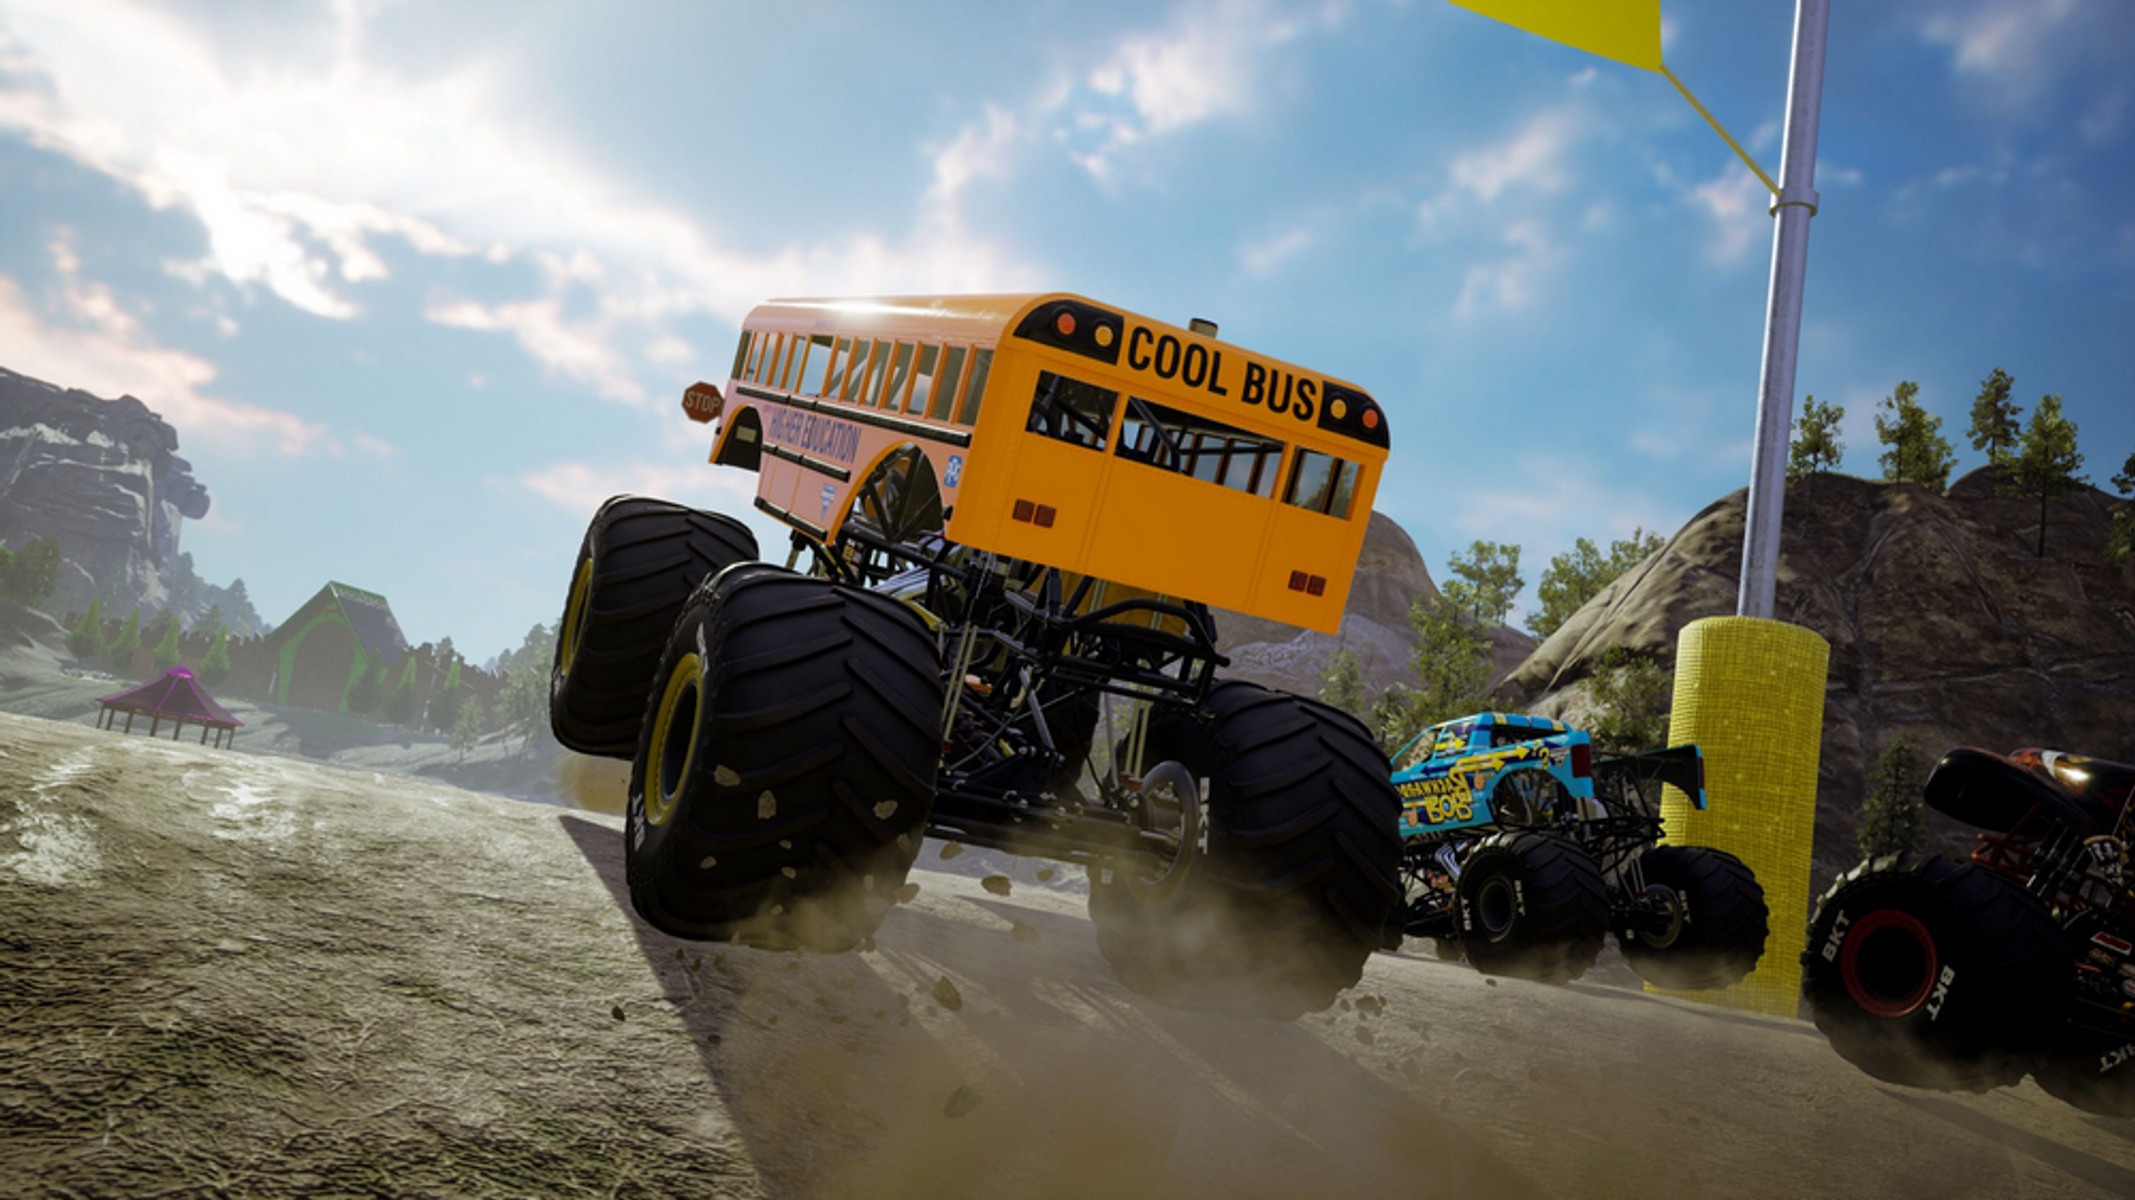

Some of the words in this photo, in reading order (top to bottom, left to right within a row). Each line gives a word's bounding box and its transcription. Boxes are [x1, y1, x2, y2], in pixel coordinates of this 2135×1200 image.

[1128, 325, 1228, 397] COOL
[1241, 361, 1317, 421] BUS
[685, 391, 721, 414] STOP
[769, 406, 804, 445] HIGHER
[801, 413, 863, 465] EDUCATION
[1821, 910, 1850, 962] BKT
[1926, 965, 1955, 1021] BKT
